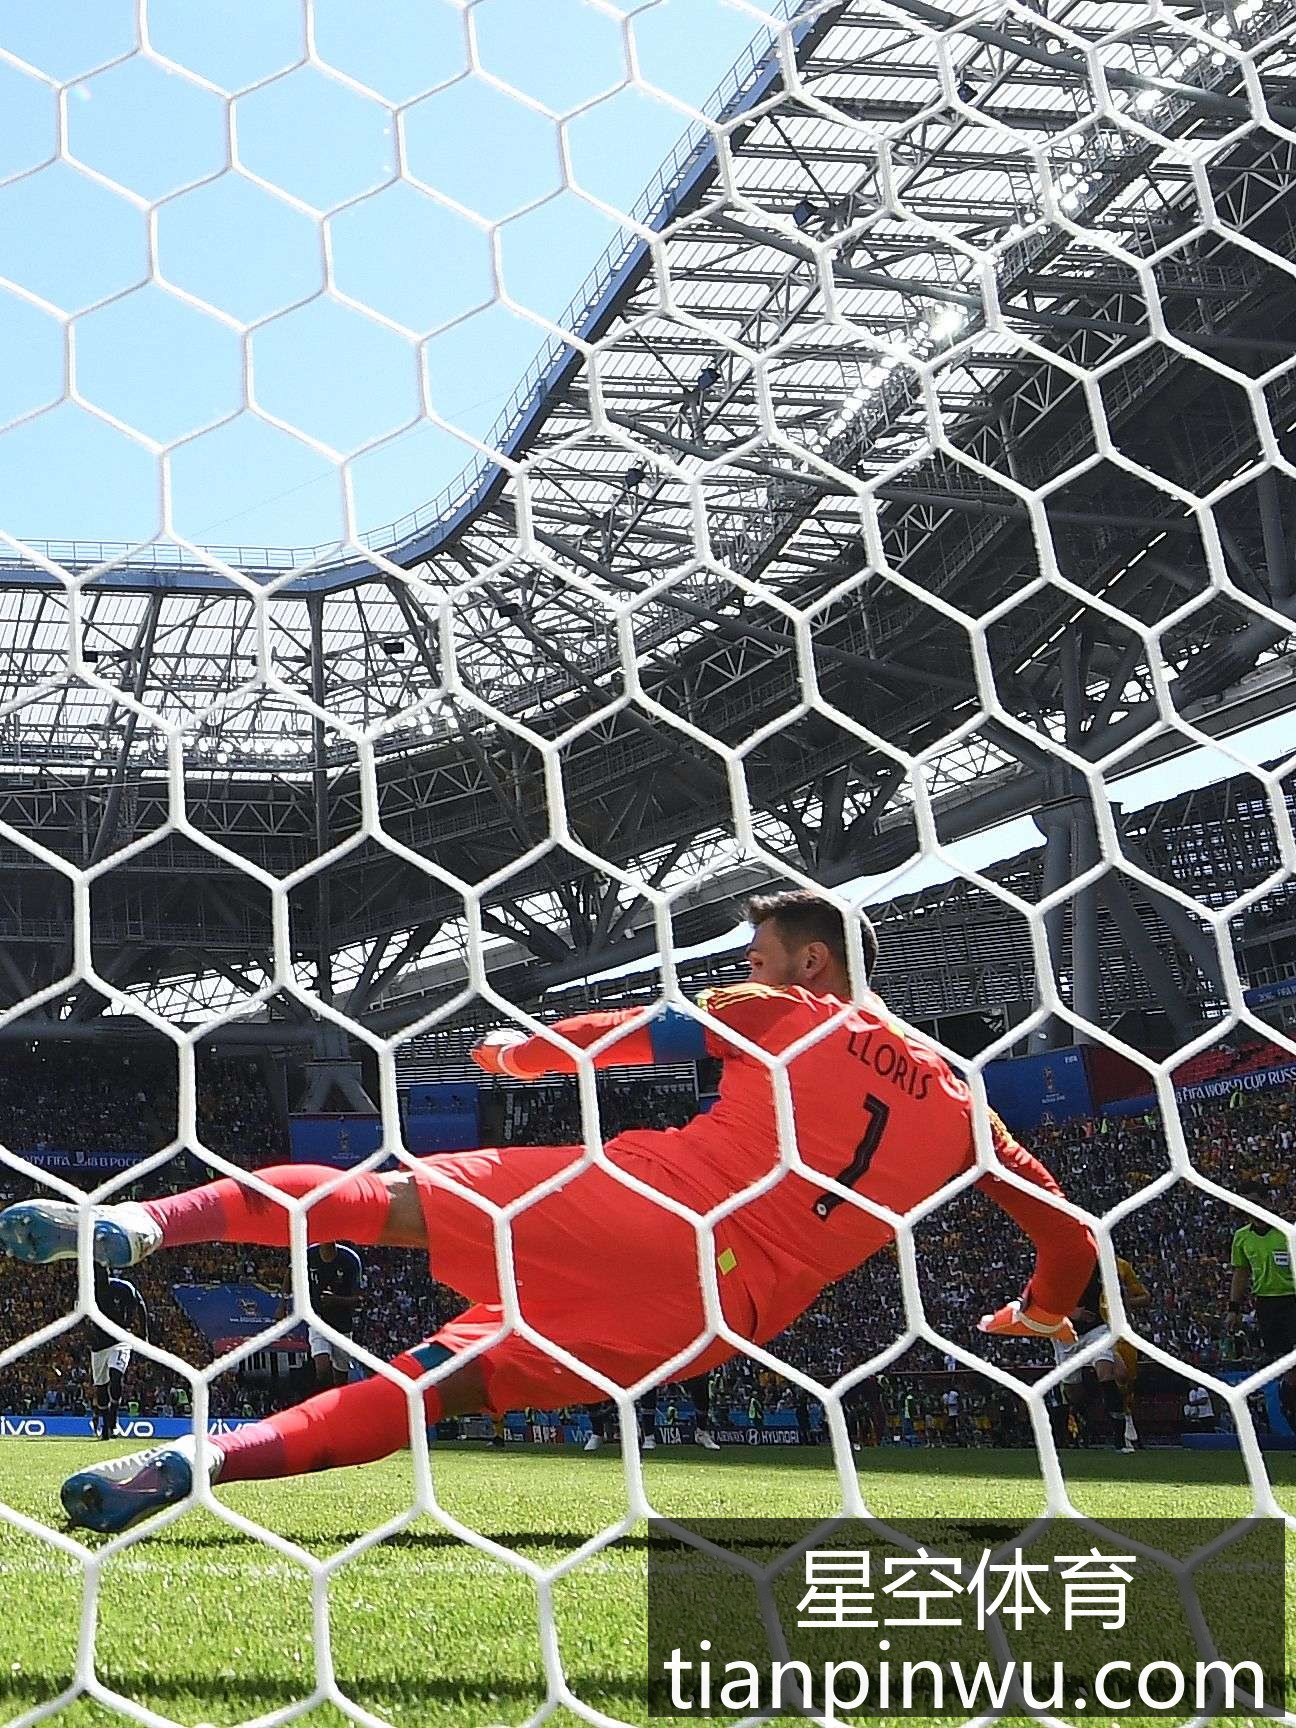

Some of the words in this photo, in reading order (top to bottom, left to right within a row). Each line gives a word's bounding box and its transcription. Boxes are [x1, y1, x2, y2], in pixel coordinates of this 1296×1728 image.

[847, 1031, 933, 1100] LLORIS
[1244, 1073, 1266, 1090] CUP
[1268, 1066, 1296, 1086] RUSS
[110, 1157, 144, 1167] РОСС
[813, 1092, 890, 1222] 1
[89, 1420, 154, 1437] vvo
[659, 1427, 681, 1444] VISA
[761, 1431, 800, 1444] HYUNDAI
